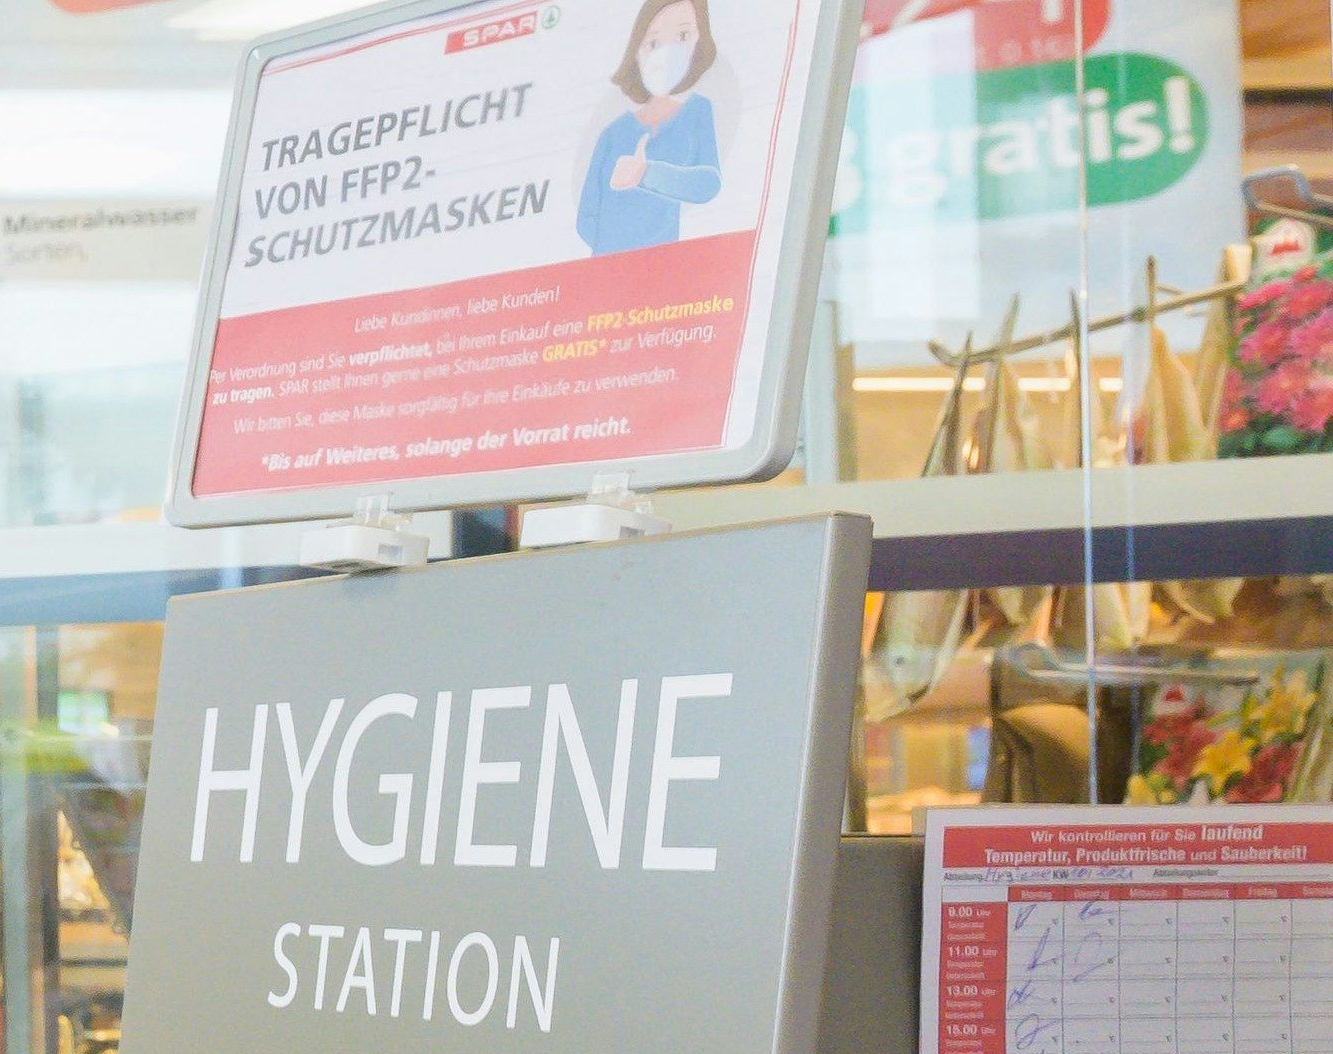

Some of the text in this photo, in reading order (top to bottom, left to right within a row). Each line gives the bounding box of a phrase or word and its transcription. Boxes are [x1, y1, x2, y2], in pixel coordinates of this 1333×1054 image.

[461, 16, 535, 49] SPAR
[260, 82, 535, 172] TRAGEPFLICHT
[884, 77, 1196, 208] gratis!
[254, 155, 437, 220] VON FFP2-
[2, 205, 199, 236] Mineralwasser
[244, 180, 551, 268] SCHUTZMASKEN
[229, 359, 297, 383] Verordnung
[299, 355, 325, 372] sind
[328, 352, 347, 369] Sie
[349, 341, 433, 367] verpflichtet,
[459, 333, 496, 352] Ihrem
[499, 321, 550, 345] Einkauf
[553, 320, 583, 337] eine
[587, 294, 734, 333] FFP2-Schutzmaske
[354, 314, 387, 333] Liebe
[467, 297, 498, 314] liebe
[501, 286, 561, 308] Kunden!
[212, 390, 228, 405] zu
[230, 385, 275, 405] tragen.
[278, 378, 310, 397] SPAR
[312, 375, 343, 393] stellt
[344, 371, 379, 390] Ihnen
[382, 367, 420, 388] gerne
[423, 363, 451, 380] eine
[453, 349, 539, 376] Schutzmaske
[609, 340, 634, 354] zur
[637, 323, 717, 349] Verfügung.
[233, 366, 679, 435] Wir bitten Sie, diese Maske sorgfältig für Ihre Einkäufe zu verwenden.
[294, 449, 323, 468] auf
[324, 443, 401, 467] Weiteres,
[405, 434, 473, 459] solange
[477, 431, 508, 451] der
[511, 424, 570, 446] Vorrat
[573, 416, 631, 438] reicht.
[190, 672, 734, 872] HYGIENE
[984, 845, 1307, 865] Temperatur, Produktfrische und Sauberkeit!
[1030, 824, 1264, 843] Wir kontrollieren für Sie laufend
[267, 922, 561, 1033] STATION
[948, 946, 979, 957] 11.00
[946, 985, 978, 996] 13.00
